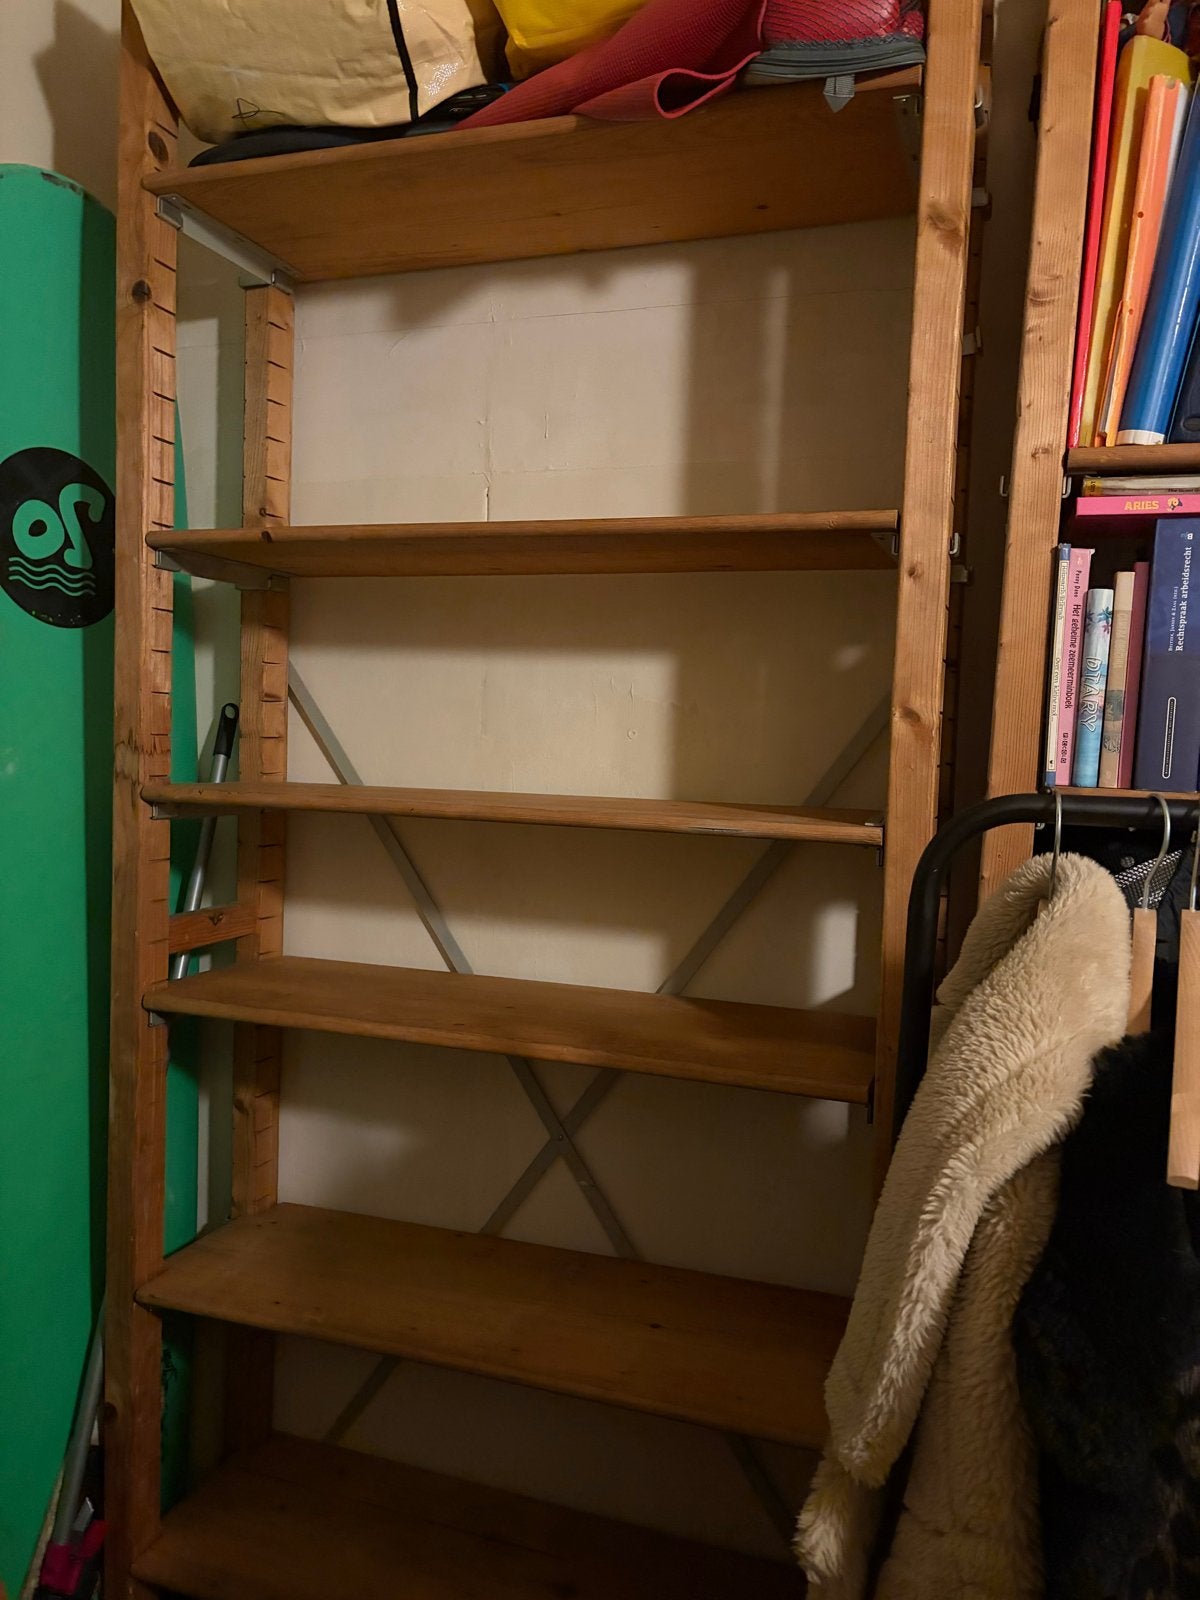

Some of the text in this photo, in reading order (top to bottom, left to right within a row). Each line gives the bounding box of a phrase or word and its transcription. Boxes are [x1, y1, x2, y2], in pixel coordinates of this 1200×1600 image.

[1124, 500, 1160, 511] ARIES
[1180, 546, 1192, 599] arbeidsrecht
[1175, 600, 1188, 652] Rechtspraak
[1064, 604, 1082, 709] Het geheime zeemeerminboek
[1080, 656, 1103, 733] DIARY
